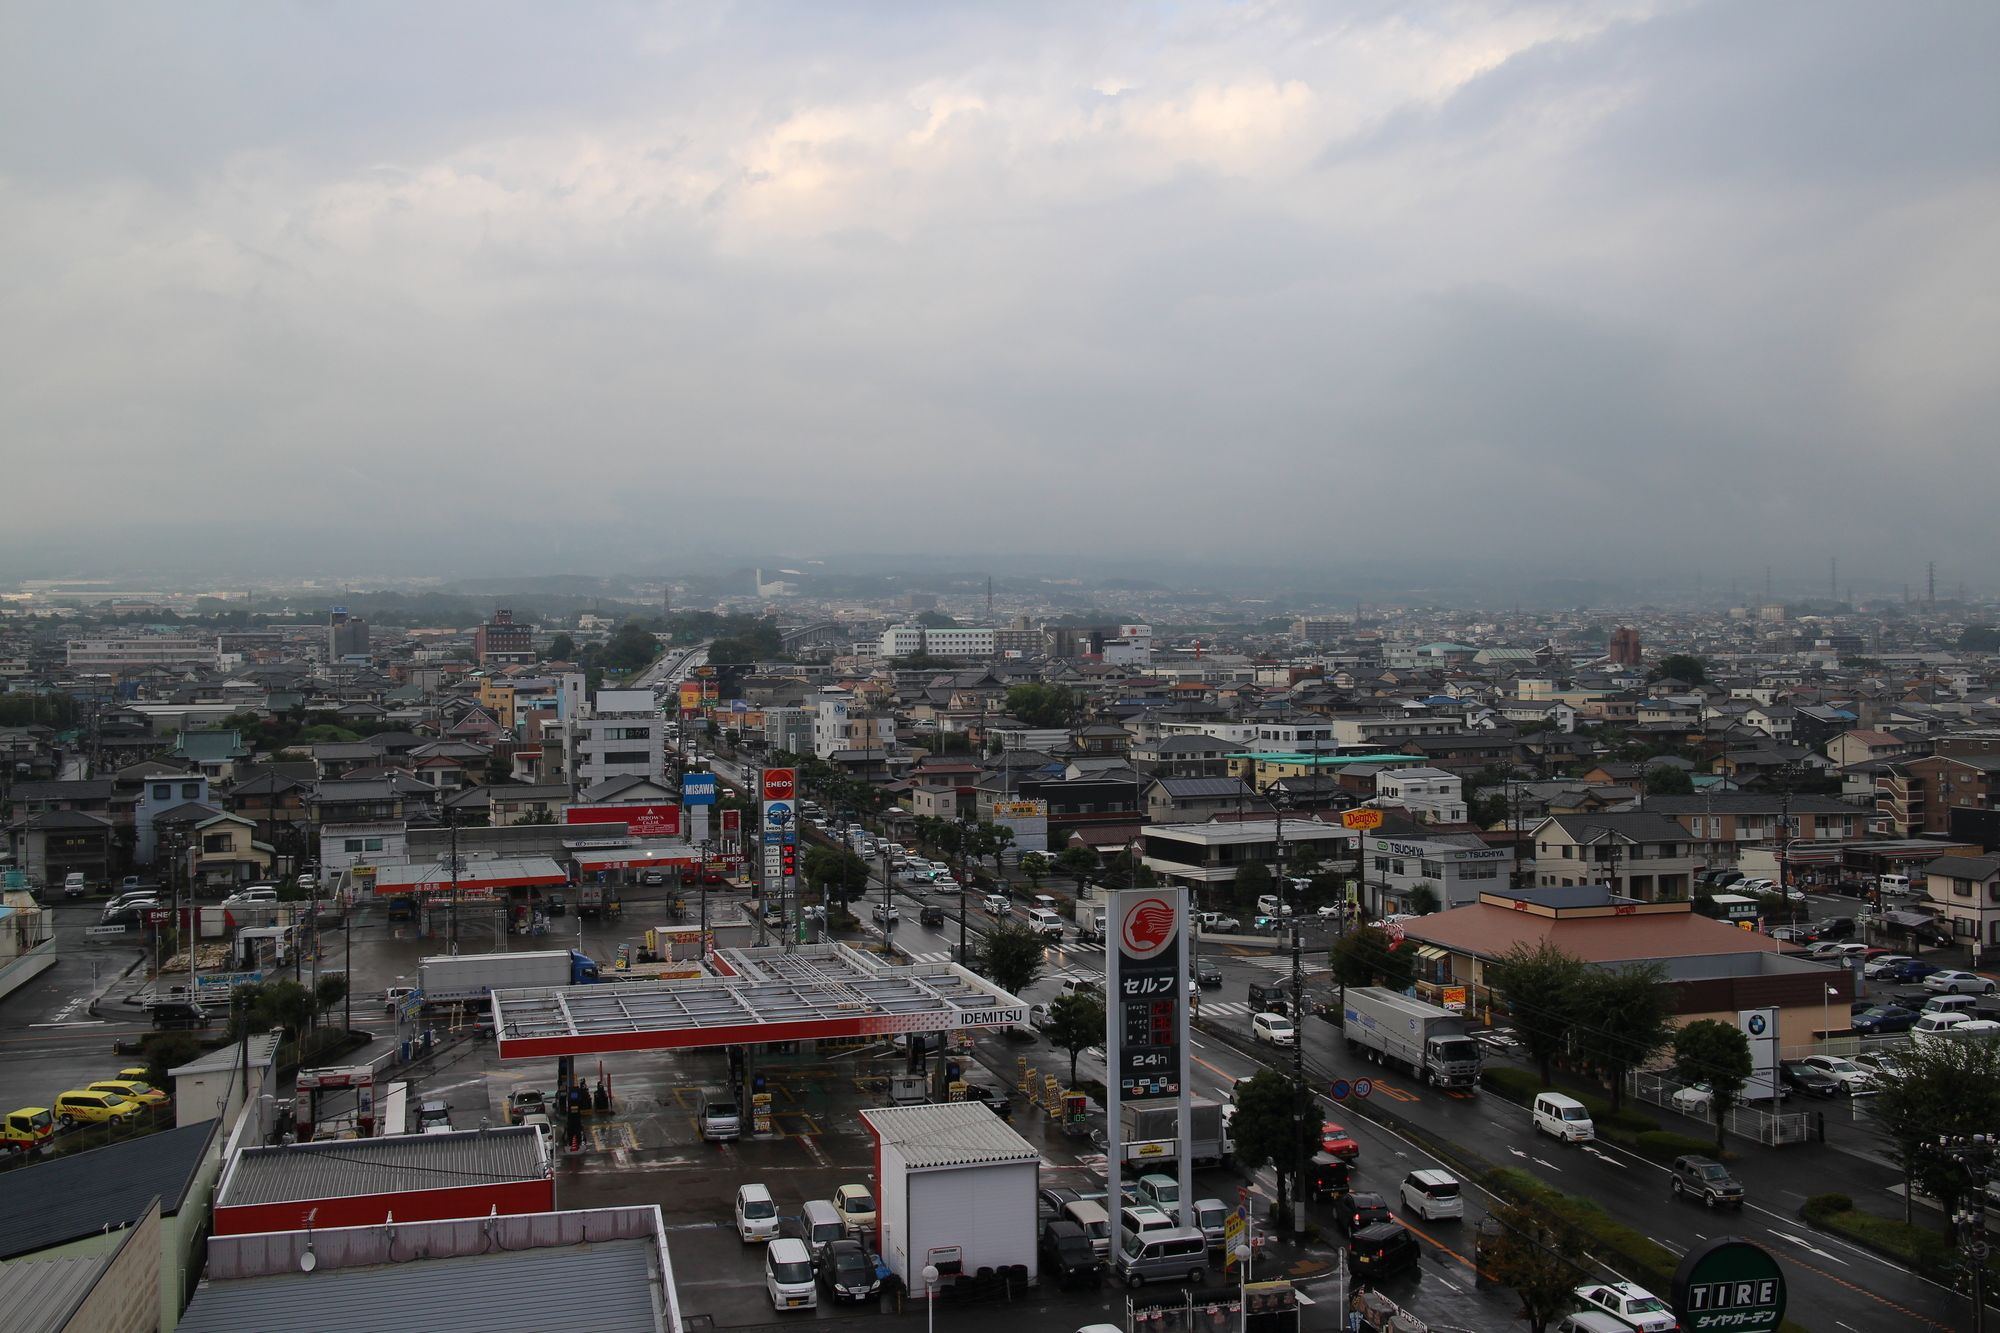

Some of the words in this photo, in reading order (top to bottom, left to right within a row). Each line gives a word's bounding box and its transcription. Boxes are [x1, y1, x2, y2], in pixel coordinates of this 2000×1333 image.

[685, 784, 715, 796] MISAWA
[766, 780, 792, 788] ENEOS
[1347, 811, 1378, 826] Denny's
[1390, 842, 1424, 858] TSUCHIYA
[1469, 850, 1504, 859] TSUCHIYA
[722, 855, 745, 863] ENEOS
[1123, 977, 1174, 995] セルフ
[961, 1010, 1023, 1025] IDEMITSU
[1132, 1054, 1168, 1067] 24h
[1357, 1084, 1368, 1093] 50
[1073, 1113, 1086, 1121] 105
[1693, 1281, 1773, 1308] TIRE
[1696, 1310, 1776, 1328] タイヤガーデン
